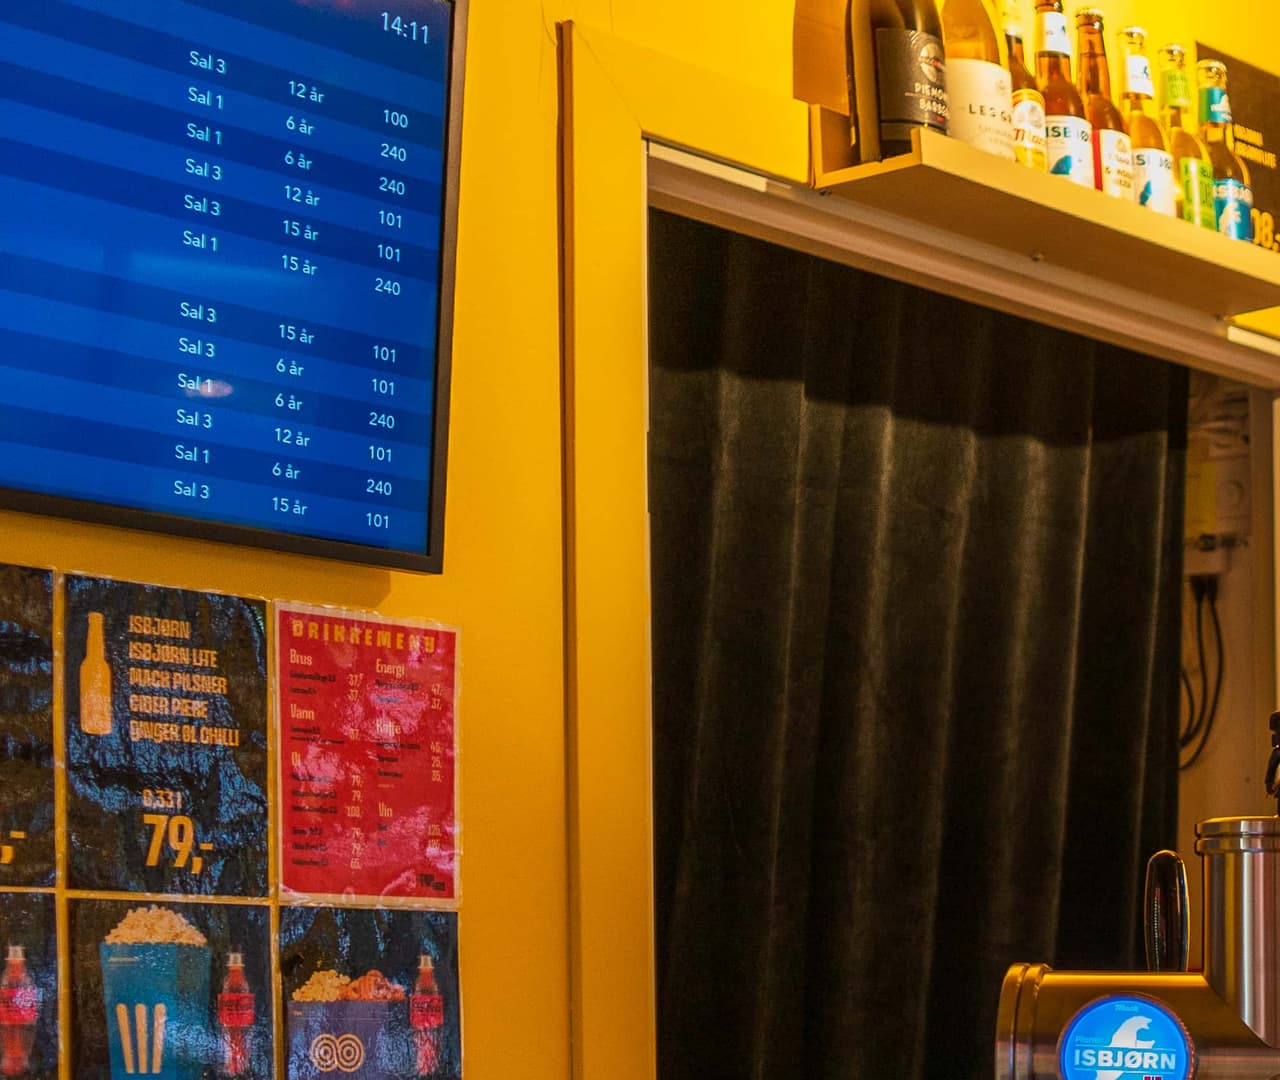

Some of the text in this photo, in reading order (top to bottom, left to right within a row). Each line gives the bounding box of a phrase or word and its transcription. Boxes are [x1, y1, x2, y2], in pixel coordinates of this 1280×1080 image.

[380, 11, 429, 44] 14:11
[189, 50, 409, 129] Sal 3 12 år 100
[188, 86, 407, 162] Sal 1 6 år 240
[186, 122, 405, 196] Sal 1 6 år 240
[185, 158, 402, 229] Sal 3 12 år 101
[184, 194, 401, 263] Sal 3 15 år 101
[183, 230, 401, 296] Sal 1 15 år 240
[180, 301, 396, 363] Sal 3 15 år 101
[178, 337, 395, 396] Sal 3 6 år 101
[176, 372, 201, 392] Sal
[275, 392, 285, 407] 6
[287, 394, 303, 411] år
[369, 411, 395, 429] 240
[176, 408, 392, 463] Sal 3 12 år 101
[175, 444, 393, 496] Sal 1 6 år 240
[173, 479, 389, 529] Sal 3 15 år 101
[290, 647, 313, 666] Brus
[290, 703, 315, 721] Vann
[142, 813, 214, 874] 79,-
[1074, 1048, 1177, 1070] ISBJØRN
